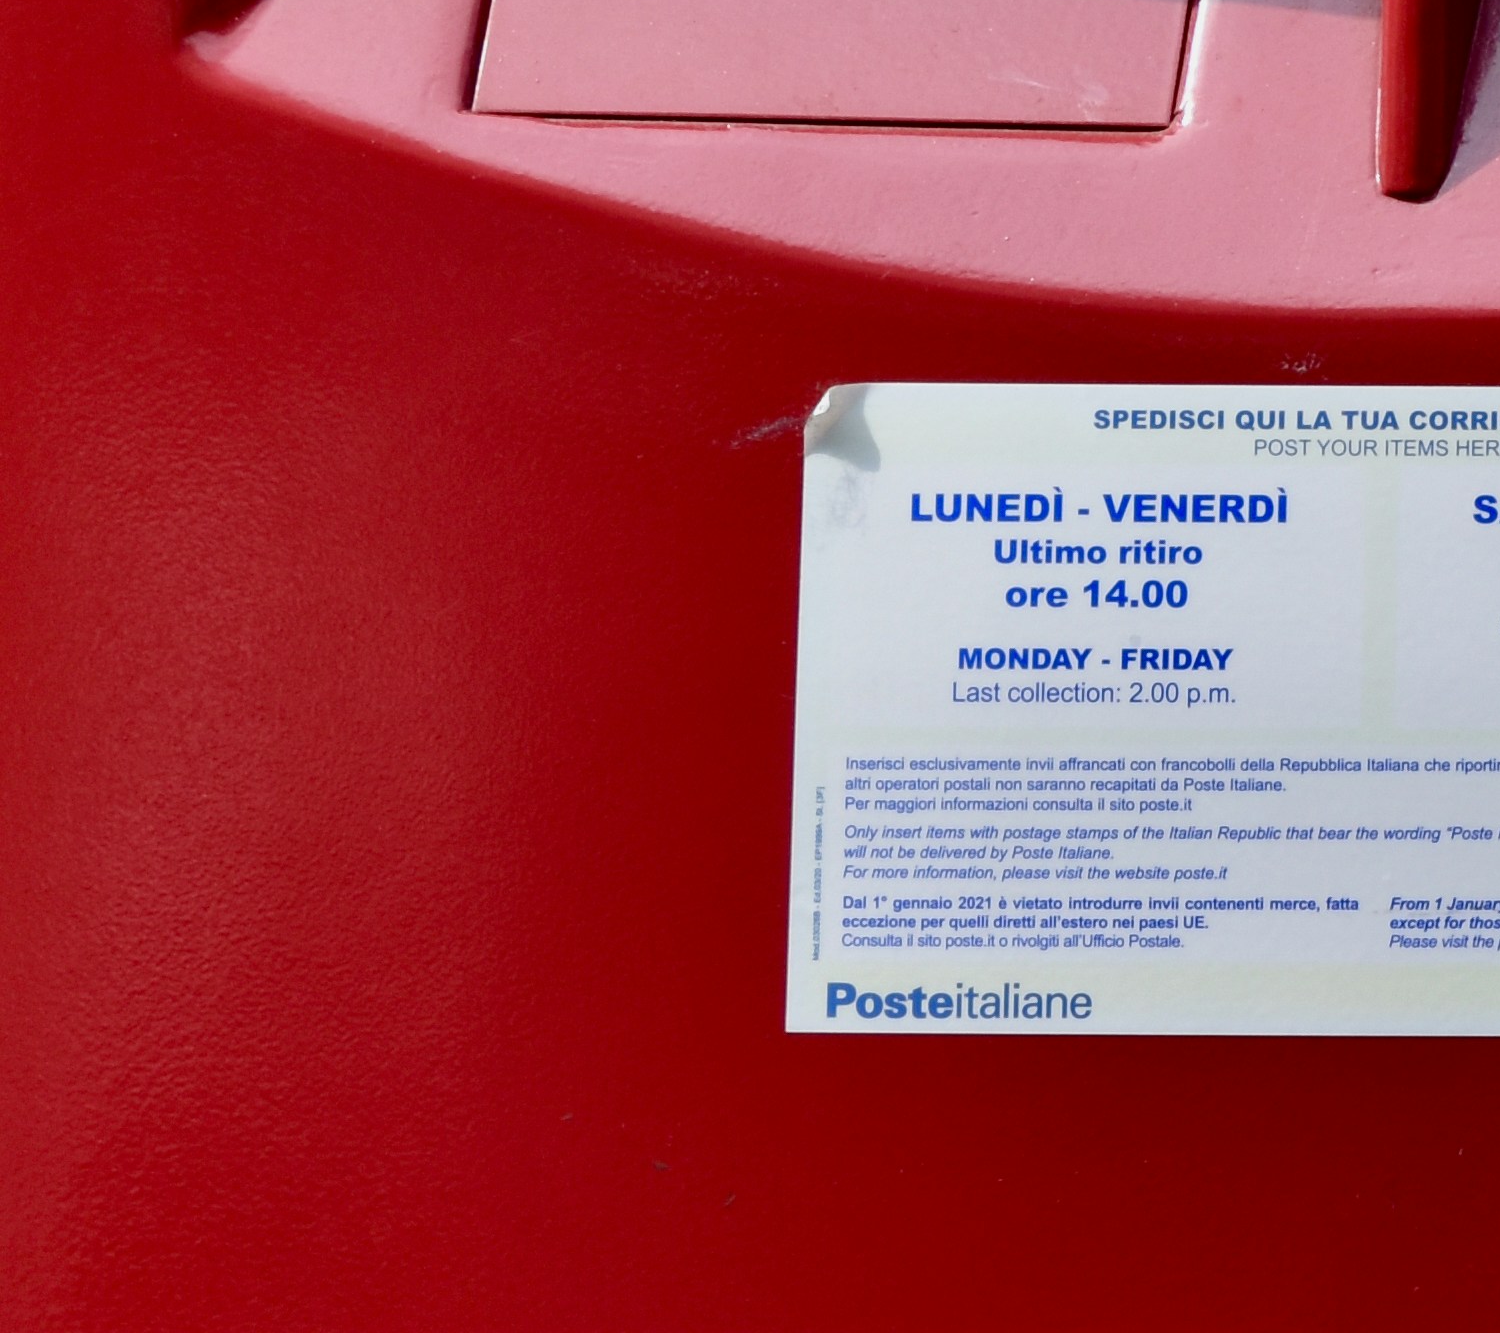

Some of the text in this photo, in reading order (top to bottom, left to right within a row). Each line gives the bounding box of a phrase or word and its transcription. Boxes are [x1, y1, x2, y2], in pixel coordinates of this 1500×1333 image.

[1093, 409, 1225, 430] SPEDISCI
[1234, 409, 1286, 432] QUI
[1296, 410, 1333, 431] LA
[1340, 410, 1400, 431] TUA
[1253, 438, 1312, 457] POST
[1316, 438, 1378, 457] YOUR
[1384, 438, 1449, 457] ITEMS
[910, 486, 1288, 524] LUNEDÌ - VENERDÌ
[994, 538, 1203, 565] Ultimo ritiro
[1005, 579, 1189, 609] ore 14.00
[958, 647, 1093, 671] MONDAY
[1120, 647, 1234, 671] FRIDAY
[952, 681, 1236, 709] Last collection: 2.00 p.m.
[843, 844, 1115, 862] will not be delivered by Poste Italiane.
[842, 864, 1229, 883] For more information, please visit the website poste.it
[1389, 916, 1442, 932] except
[1443, 915, 1467, 930] for
[825, 981, 1094, 1021] Posteitaliane
